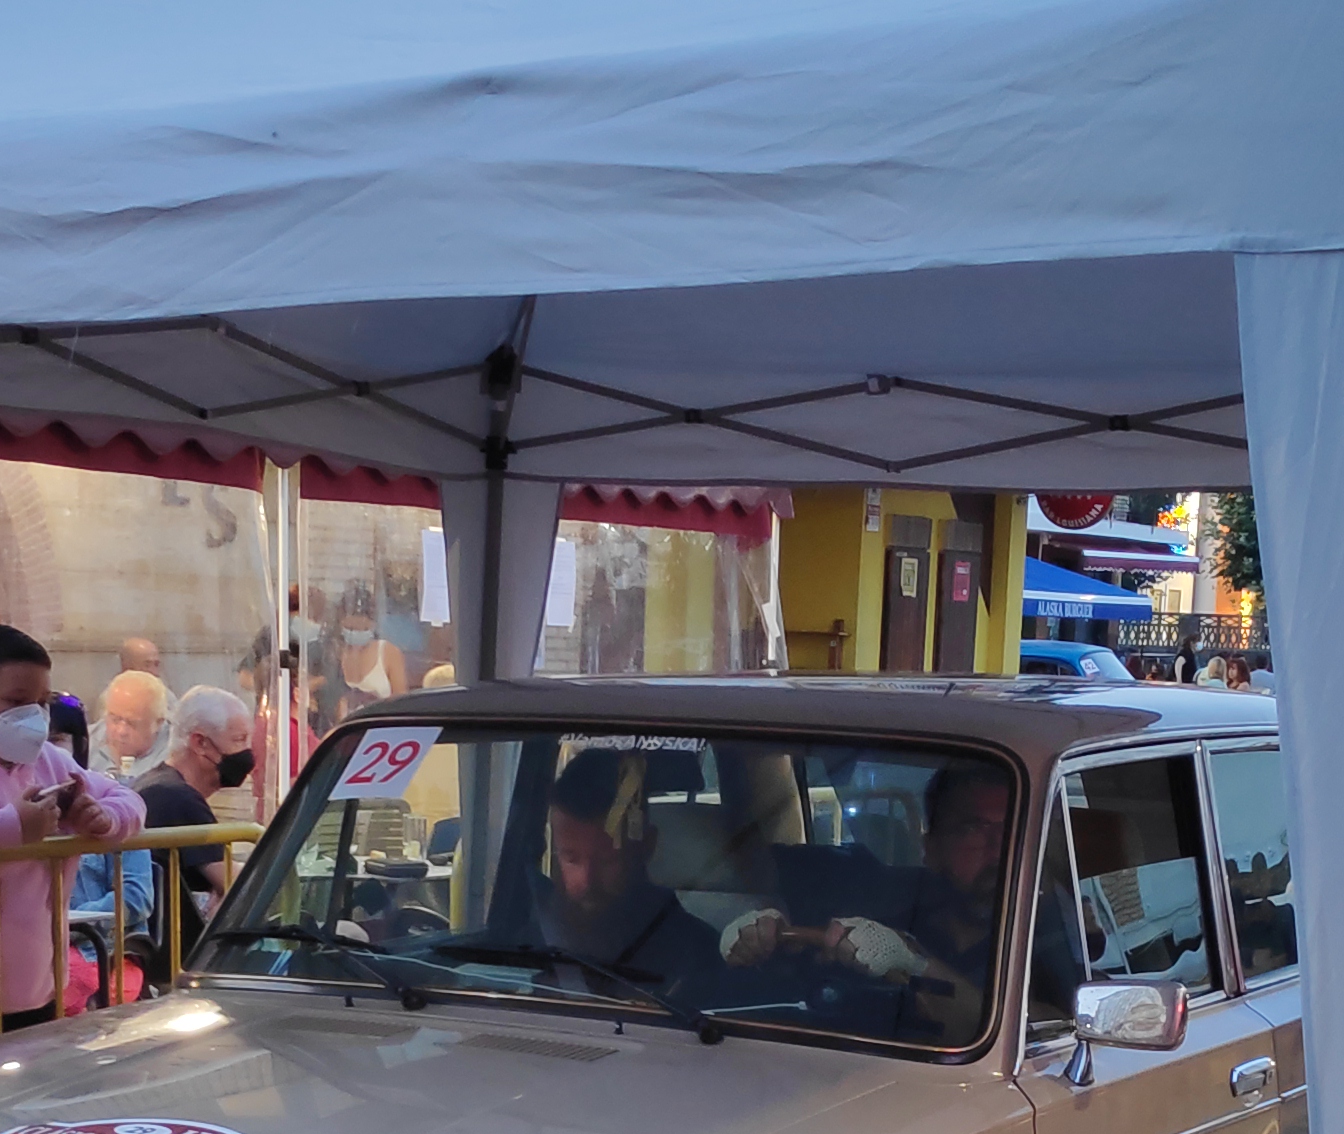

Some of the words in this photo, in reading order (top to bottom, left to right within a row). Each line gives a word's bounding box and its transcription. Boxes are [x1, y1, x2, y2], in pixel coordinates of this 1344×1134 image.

[1057, 503, 1104, 527] LOUISIANA
[1037, 600, 1064, 617] ALASKA
[1064, 602, 1094, 618] BURGUER
[1083, 661, 1097, 671] 42
[344, 741, 421, 785] 29
